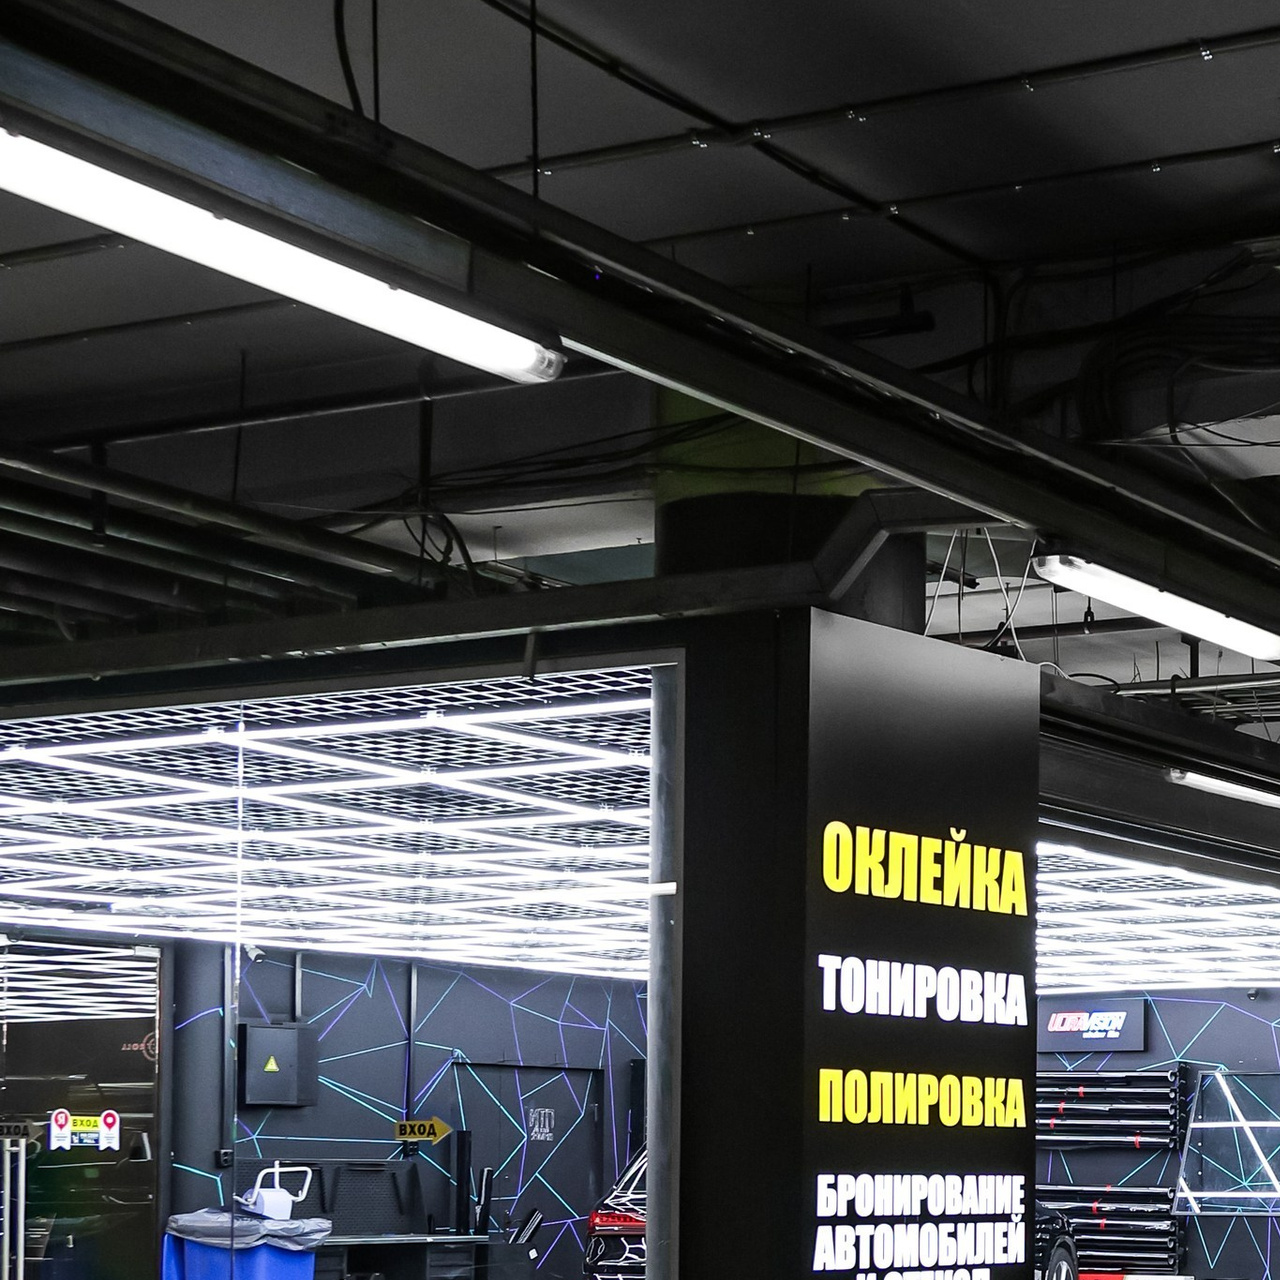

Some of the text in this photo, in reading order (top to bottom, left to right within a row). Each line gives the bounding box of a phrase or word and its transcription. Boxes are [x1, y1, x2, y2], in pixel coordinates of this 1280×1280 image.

[822, 820, 1029, 917] ОКЛЕЙКА
[817, 953, 1029, 1026] ТОНИРОВКА
[72, 1119, 99, 1128] ВХОД
[818, 1068, 1027, 1128] ПОЛИРОВКА
[398, 1123, 437, 1137] ВХОД
[816, 1173, 1026, 1218] БРОНИРОВАНИЕ
[812, 1214, 1026, 1271] АВТОМОБИЛЕЙ
